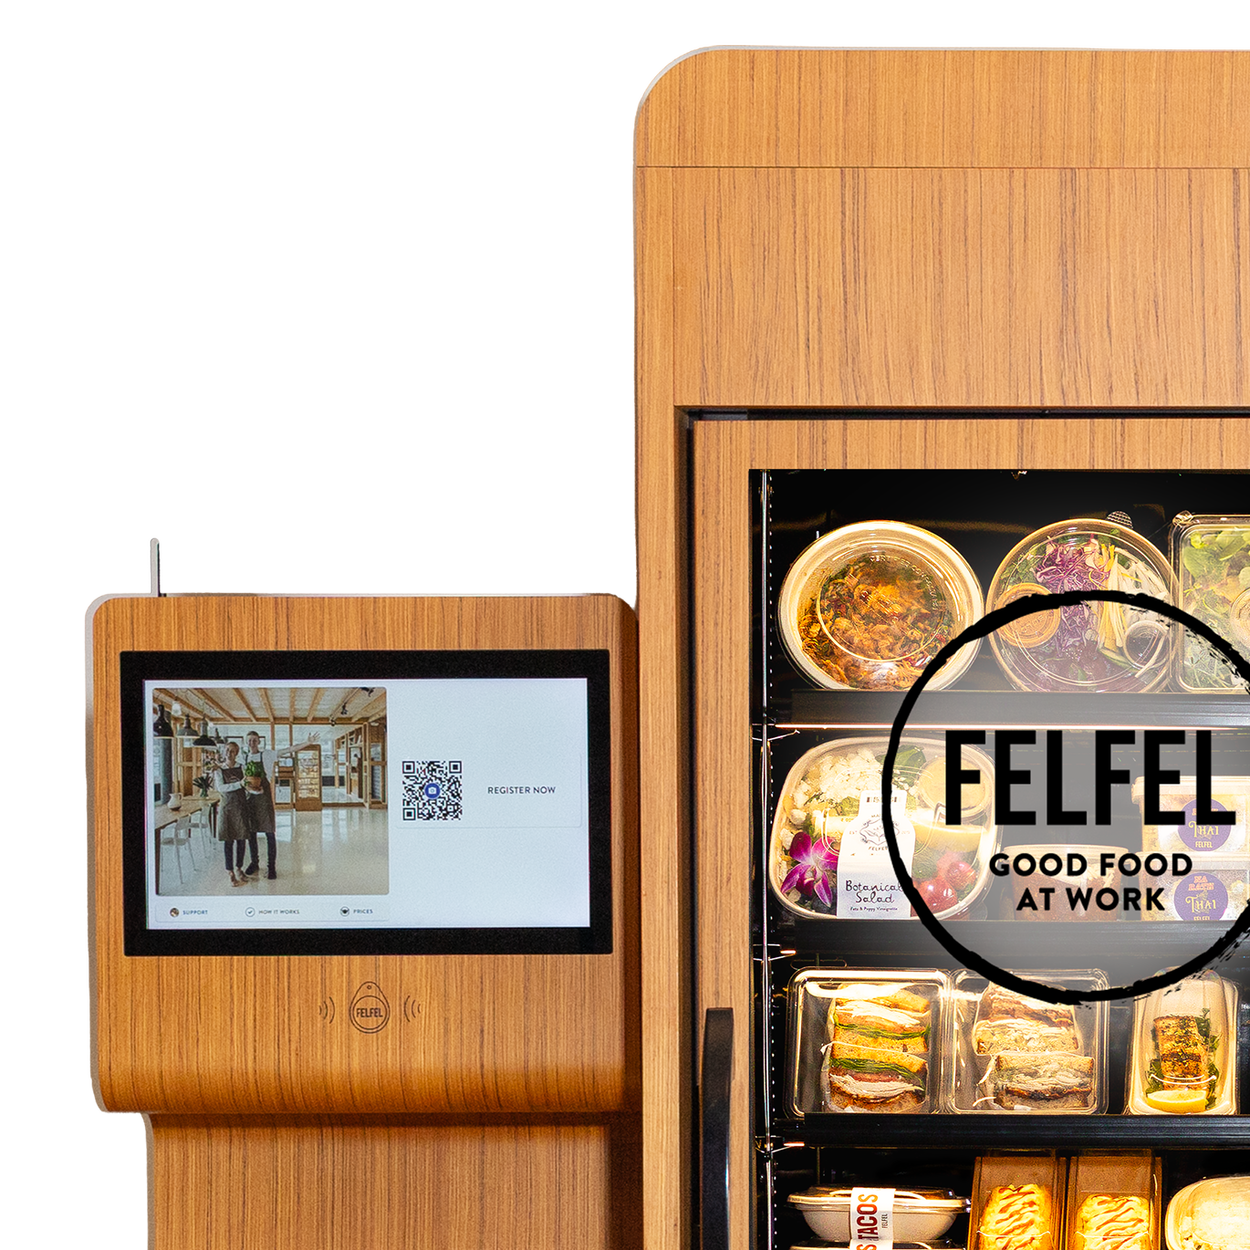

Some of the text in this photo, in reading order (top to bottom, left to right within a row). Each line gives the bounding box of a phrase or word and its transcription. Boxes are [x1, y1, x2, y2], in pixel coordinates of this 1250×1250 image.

[945, 730, 1236, 826] FELFEL
[487, 785, 557, 795] REGISTER NOW
[989, 853, 1193, 877] GOOD FOOD
[845, 880, 903, 892] Botanical
[855, 891, 895, 903] Salad
[1016, 887, 1165, 911] AT WORK
[356, 1007, 383, 1018] FELFEL
[856, 1194, 879, 1240] TACOS
